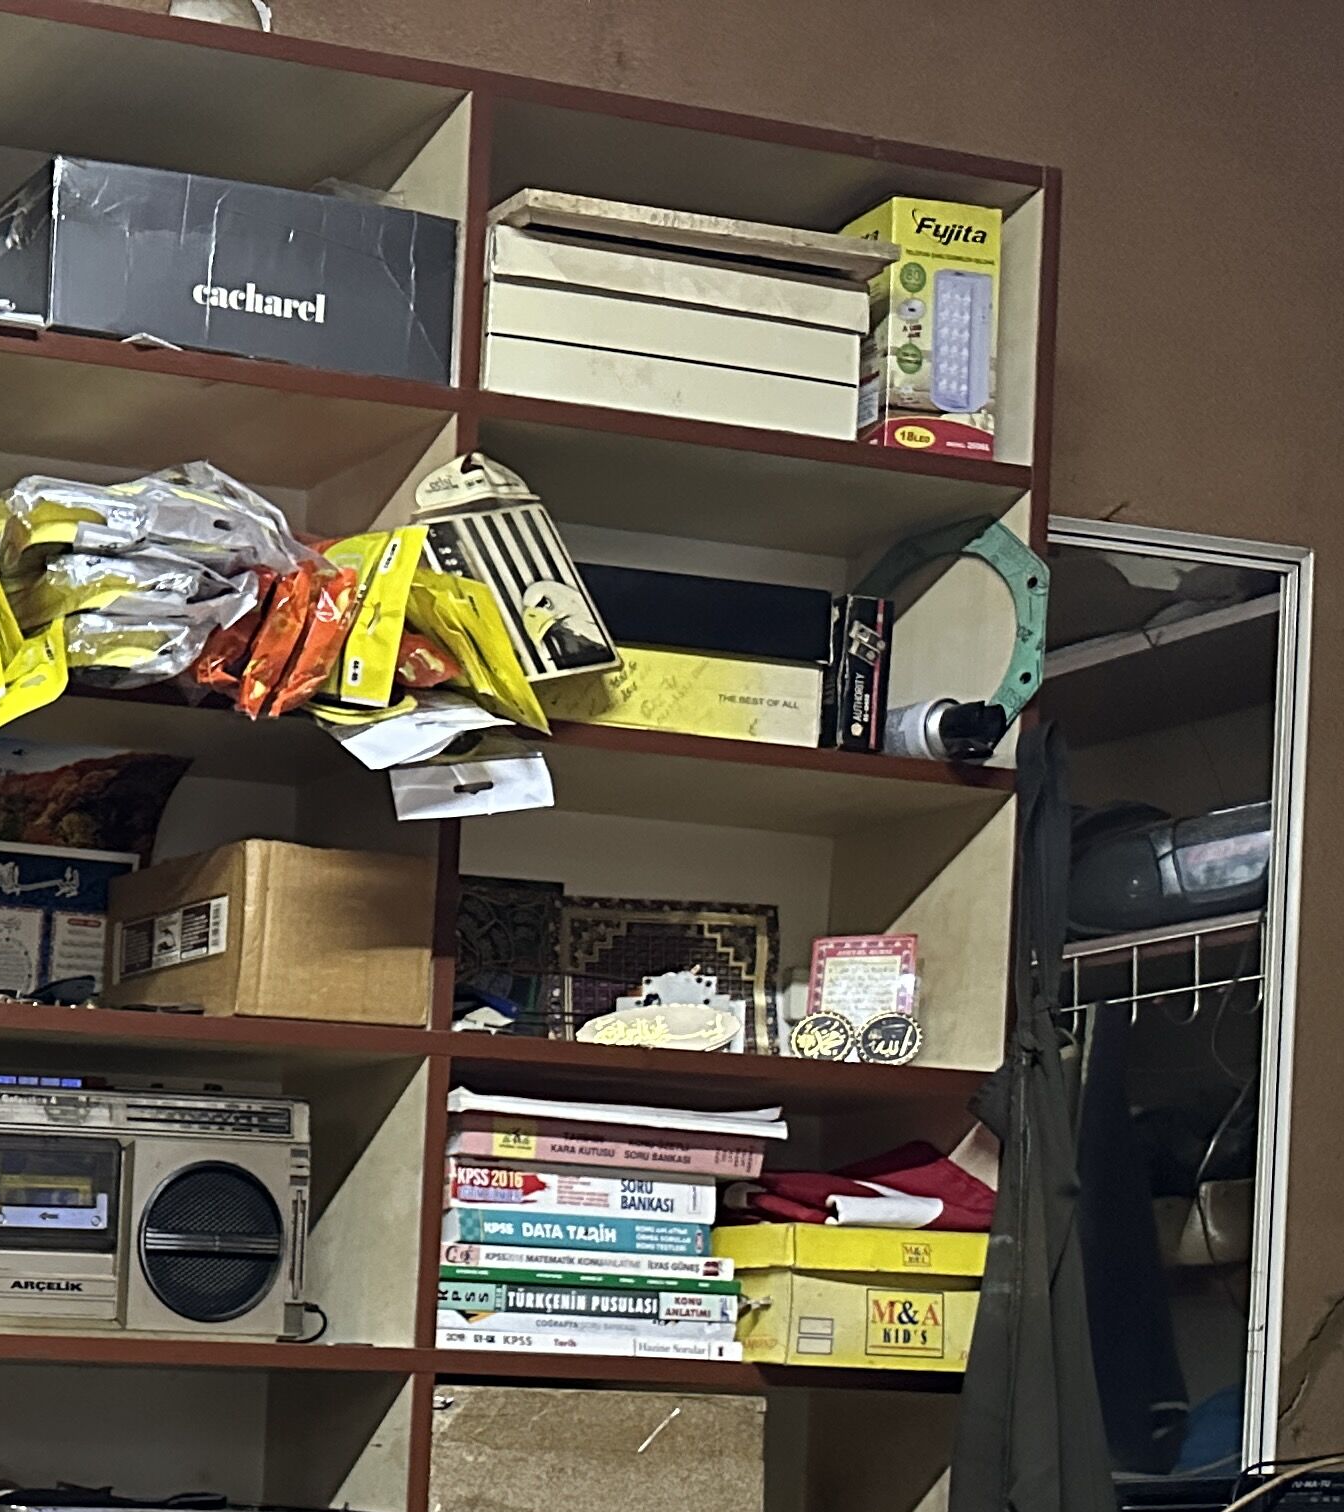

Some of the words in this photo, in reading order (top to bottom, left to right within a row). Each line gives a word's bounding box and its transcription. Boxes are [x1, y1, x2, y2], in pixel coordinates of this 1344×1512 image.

[915, 217, 987, 246] Fujita
[193, 283, 325, 324] cacharel
[719, 694, 738, 704] THE
[739, 695, 764, 706] BEST
[766, 697, 779, 707] OF
[782, 699, 799, 709] ALL
[853, 673, 865, 722] AUTHORITY
[551, 1144, 576, 1154] KARA
[624, 1151, 649, 1161] SORU
[457, 1167, 490, 1186] KPSS
[491, 1170, 524, 1188] 2016
[621, 1178, 653, 1194] SORU
[621, 1195, 674, 1213] BANKASI
[483, 1222, 514, 1234] KPSS
[522, 1222, 563, 1239] DATA
[567, 1223, 616, 1243] TARİH
[11, 1280, 83, 1293] ARÇELİK
[507, 1287, 586, 1313] TÜRKÇENİN
[591, 1296, 658, 1314] PUSULASI
[674, 1297, 703, 1306] KONU
[871, 1299, 941, 1327] M&A
[883, 1327, 927, 1345] KID'S
